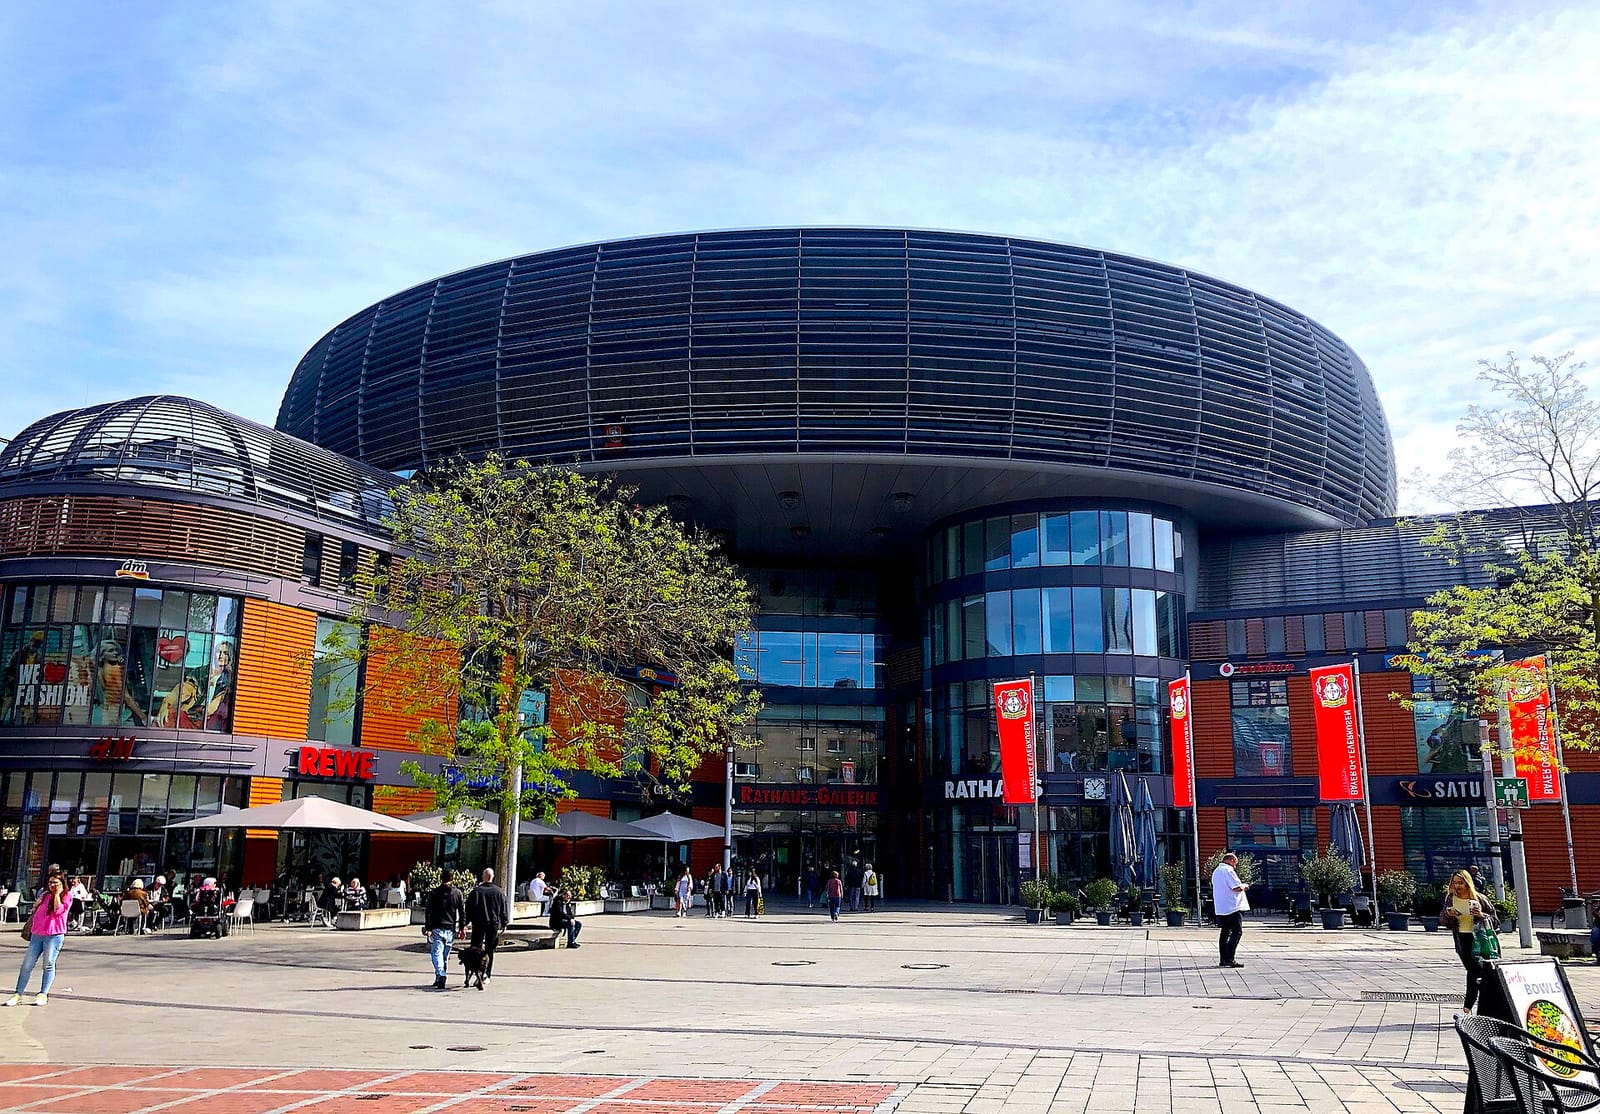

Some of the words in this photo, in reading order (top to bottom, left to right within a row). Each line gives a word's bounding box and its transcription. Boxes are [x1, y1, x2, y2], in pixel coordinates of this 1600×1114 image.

[121, 558, 147, 572] dm
[1388, 655, 1424, 666] SMYTHS
[19, 664, 40, 684] WE
[15, 685, 88, 706] FASHION
[299, 746, 375, 779] REWE
[741, 785, 809, 804] RATHAUS
[817, 786, 878, 805] GALERIE
[944, 779, 1043, 799] RATHAS
[1434, 781, 1486, 798] SATU
[1524, 982, 1561, 995] BOWLS
